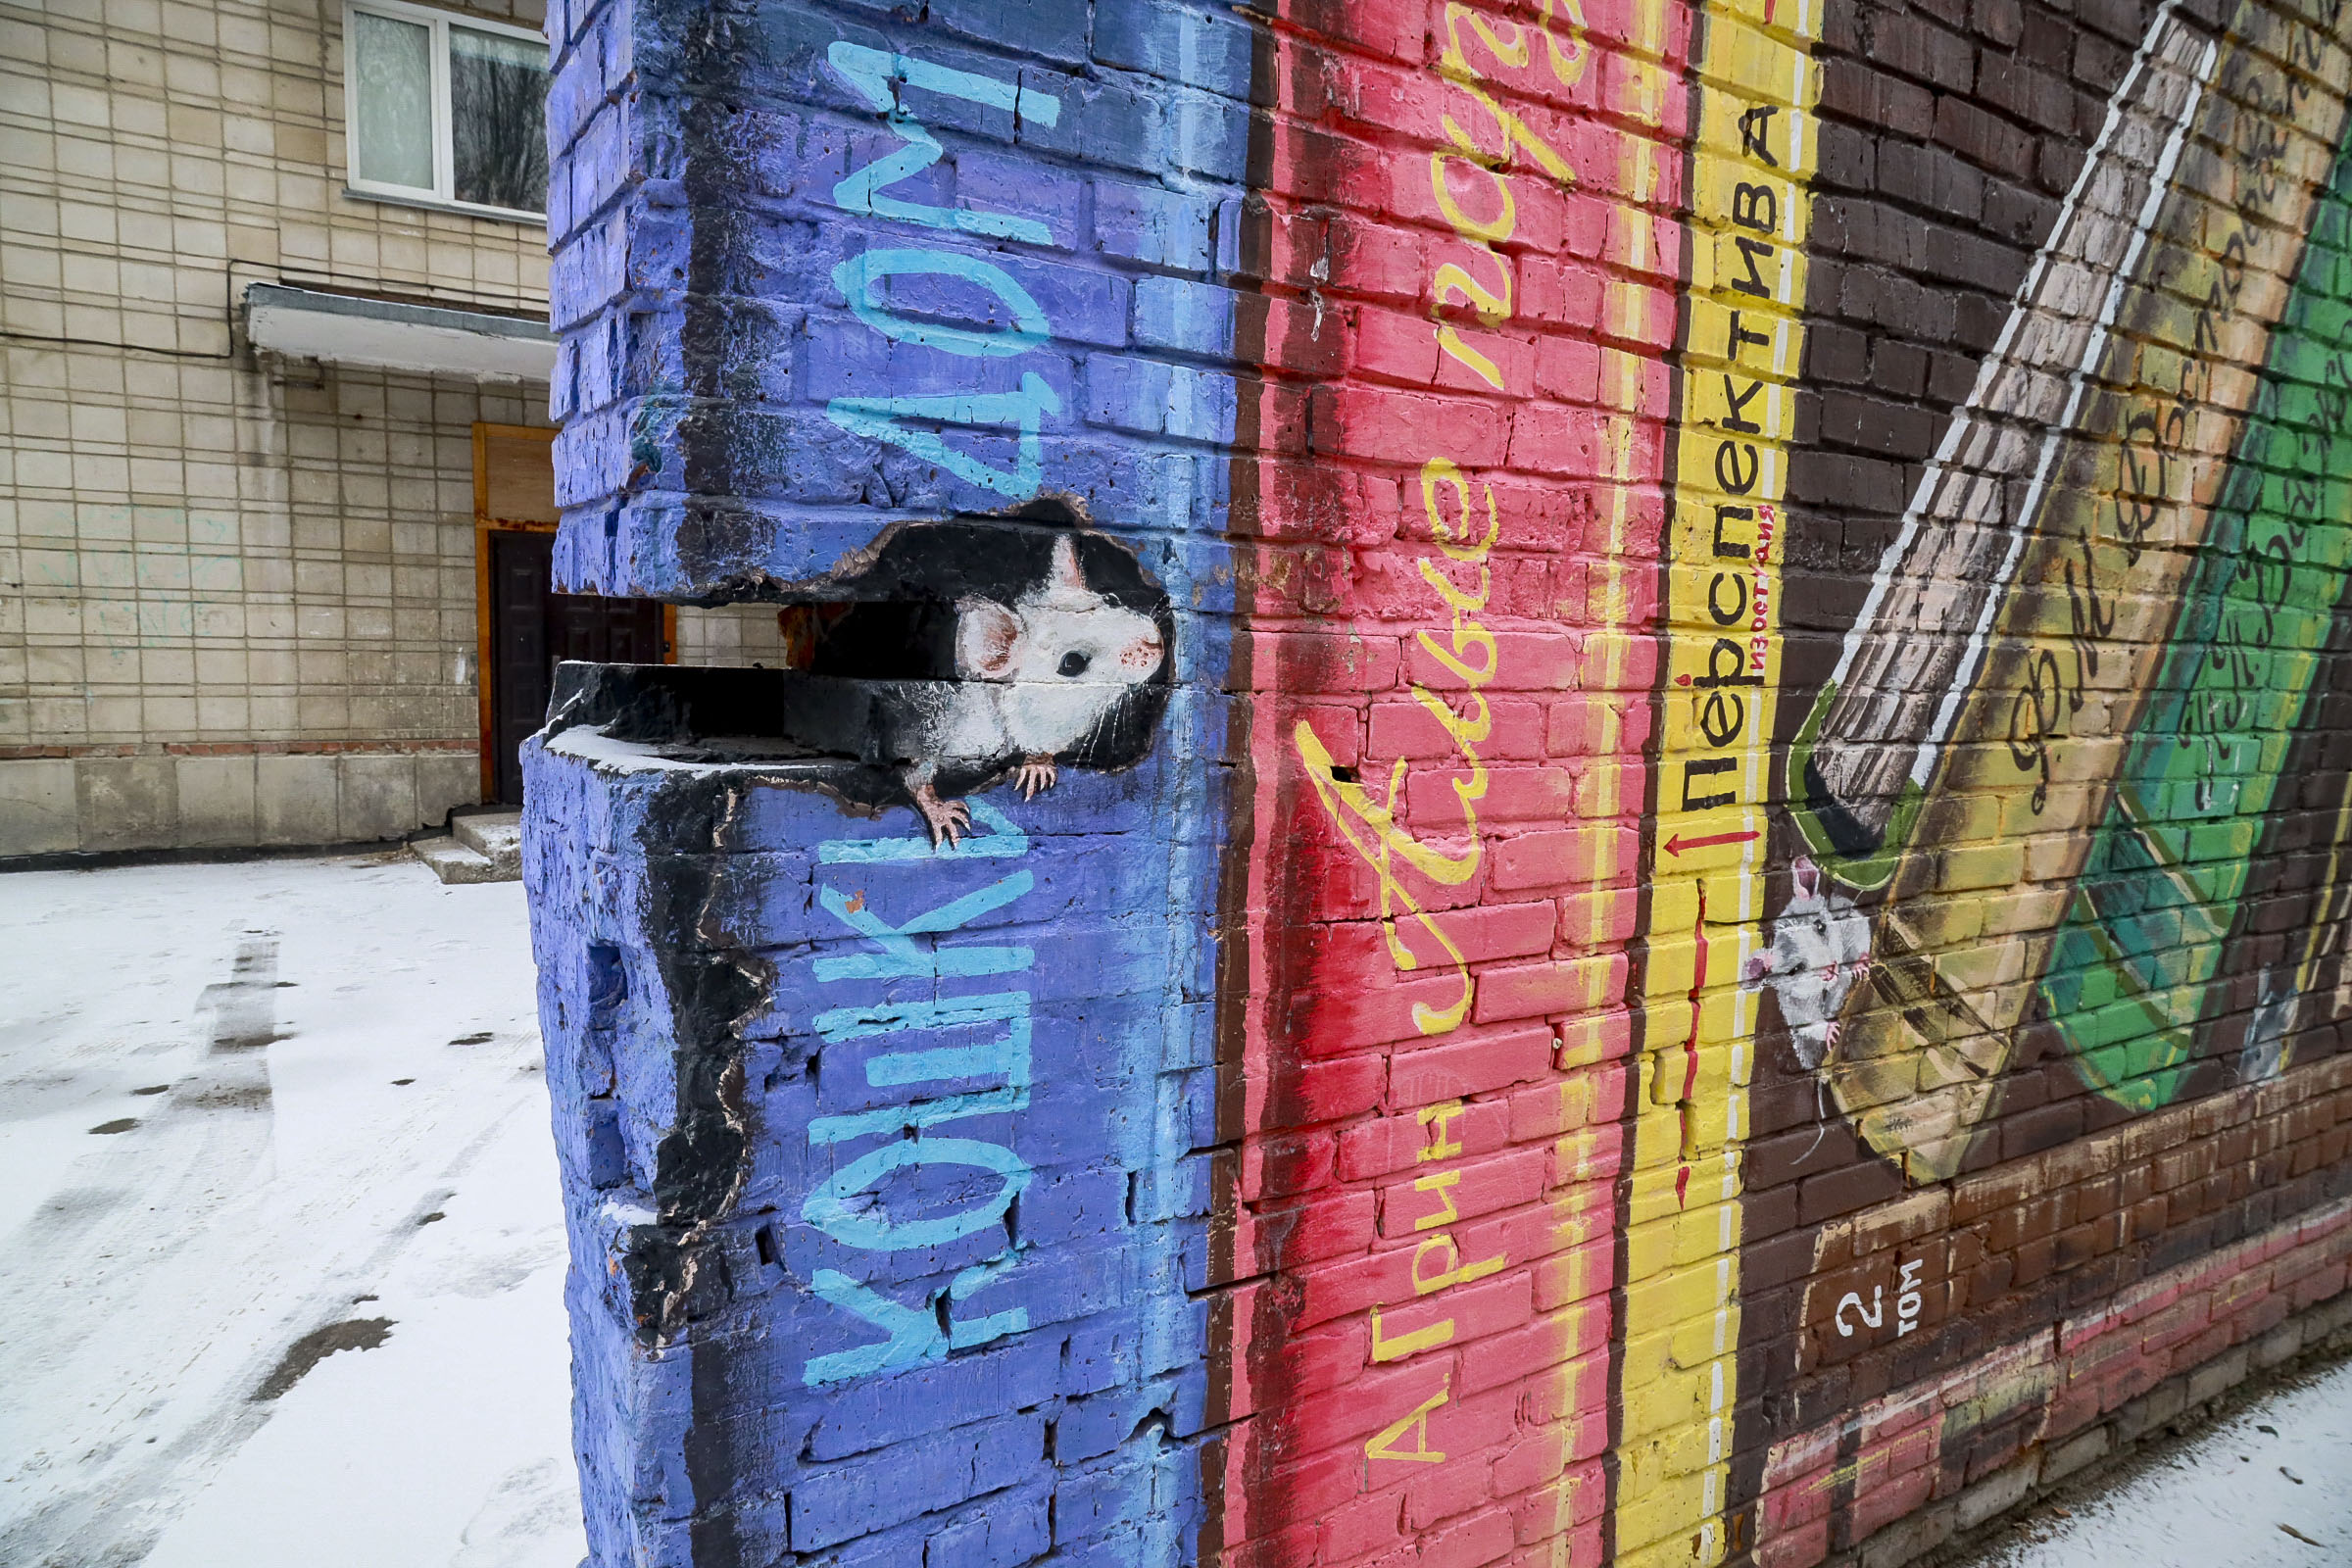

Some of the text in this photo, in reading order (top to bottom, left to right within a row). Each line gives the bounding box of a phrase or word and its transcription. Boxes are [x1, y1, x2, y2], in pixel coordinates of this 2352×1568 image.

[826, 40, 1061, 502] ДОМ
[1294, 456, 1499, 1036] Алые
[1371, 1099, 1507, 1362] Грин
[1835, 1285, 1883, 1338] 2
